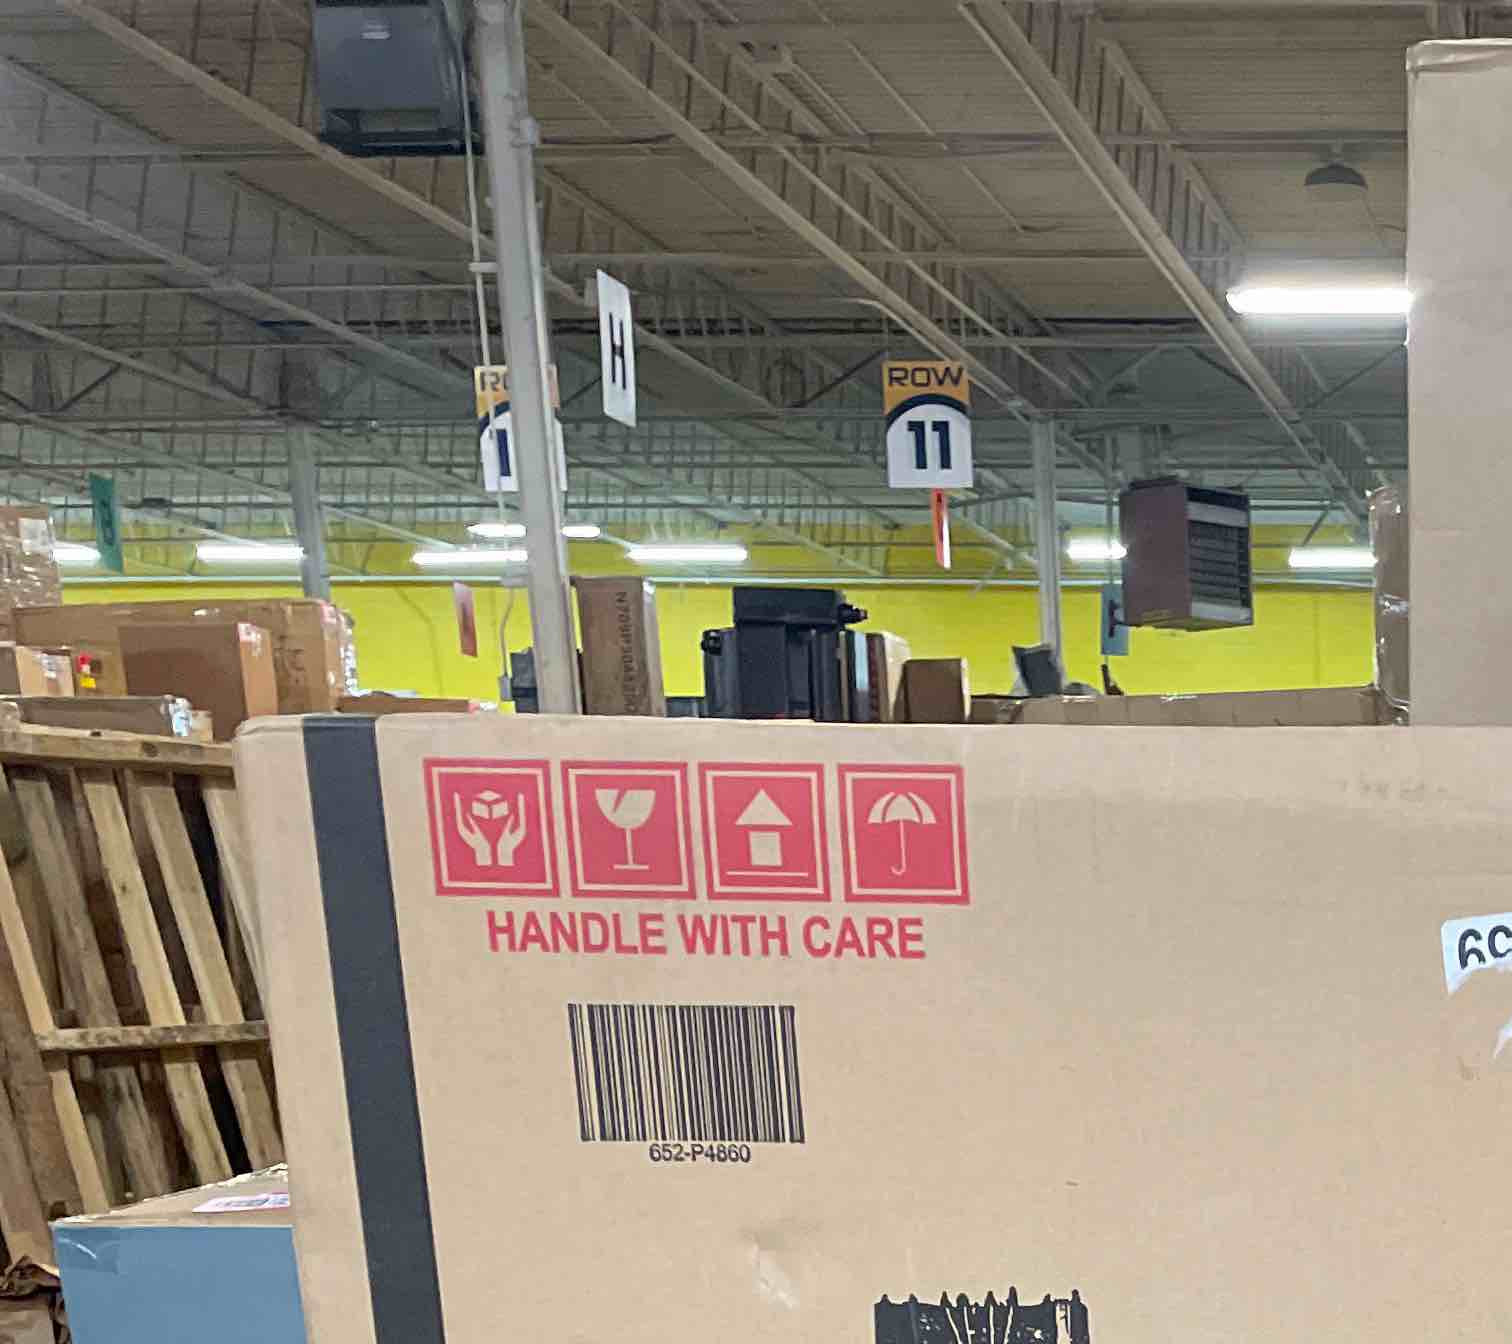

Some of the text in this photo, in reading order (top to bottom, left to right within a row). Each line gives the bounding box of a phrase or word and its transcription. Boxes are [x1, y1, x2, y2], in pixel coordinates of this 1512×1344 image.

[609, 312, 627, 391] H
[888, 366, 964, 388] ROW
[907, 420, 952, 471] 11
[486, 910, 926, 959] HANDLE WITH CARE
[648, 1143, 752, 1164] 652-P4860
